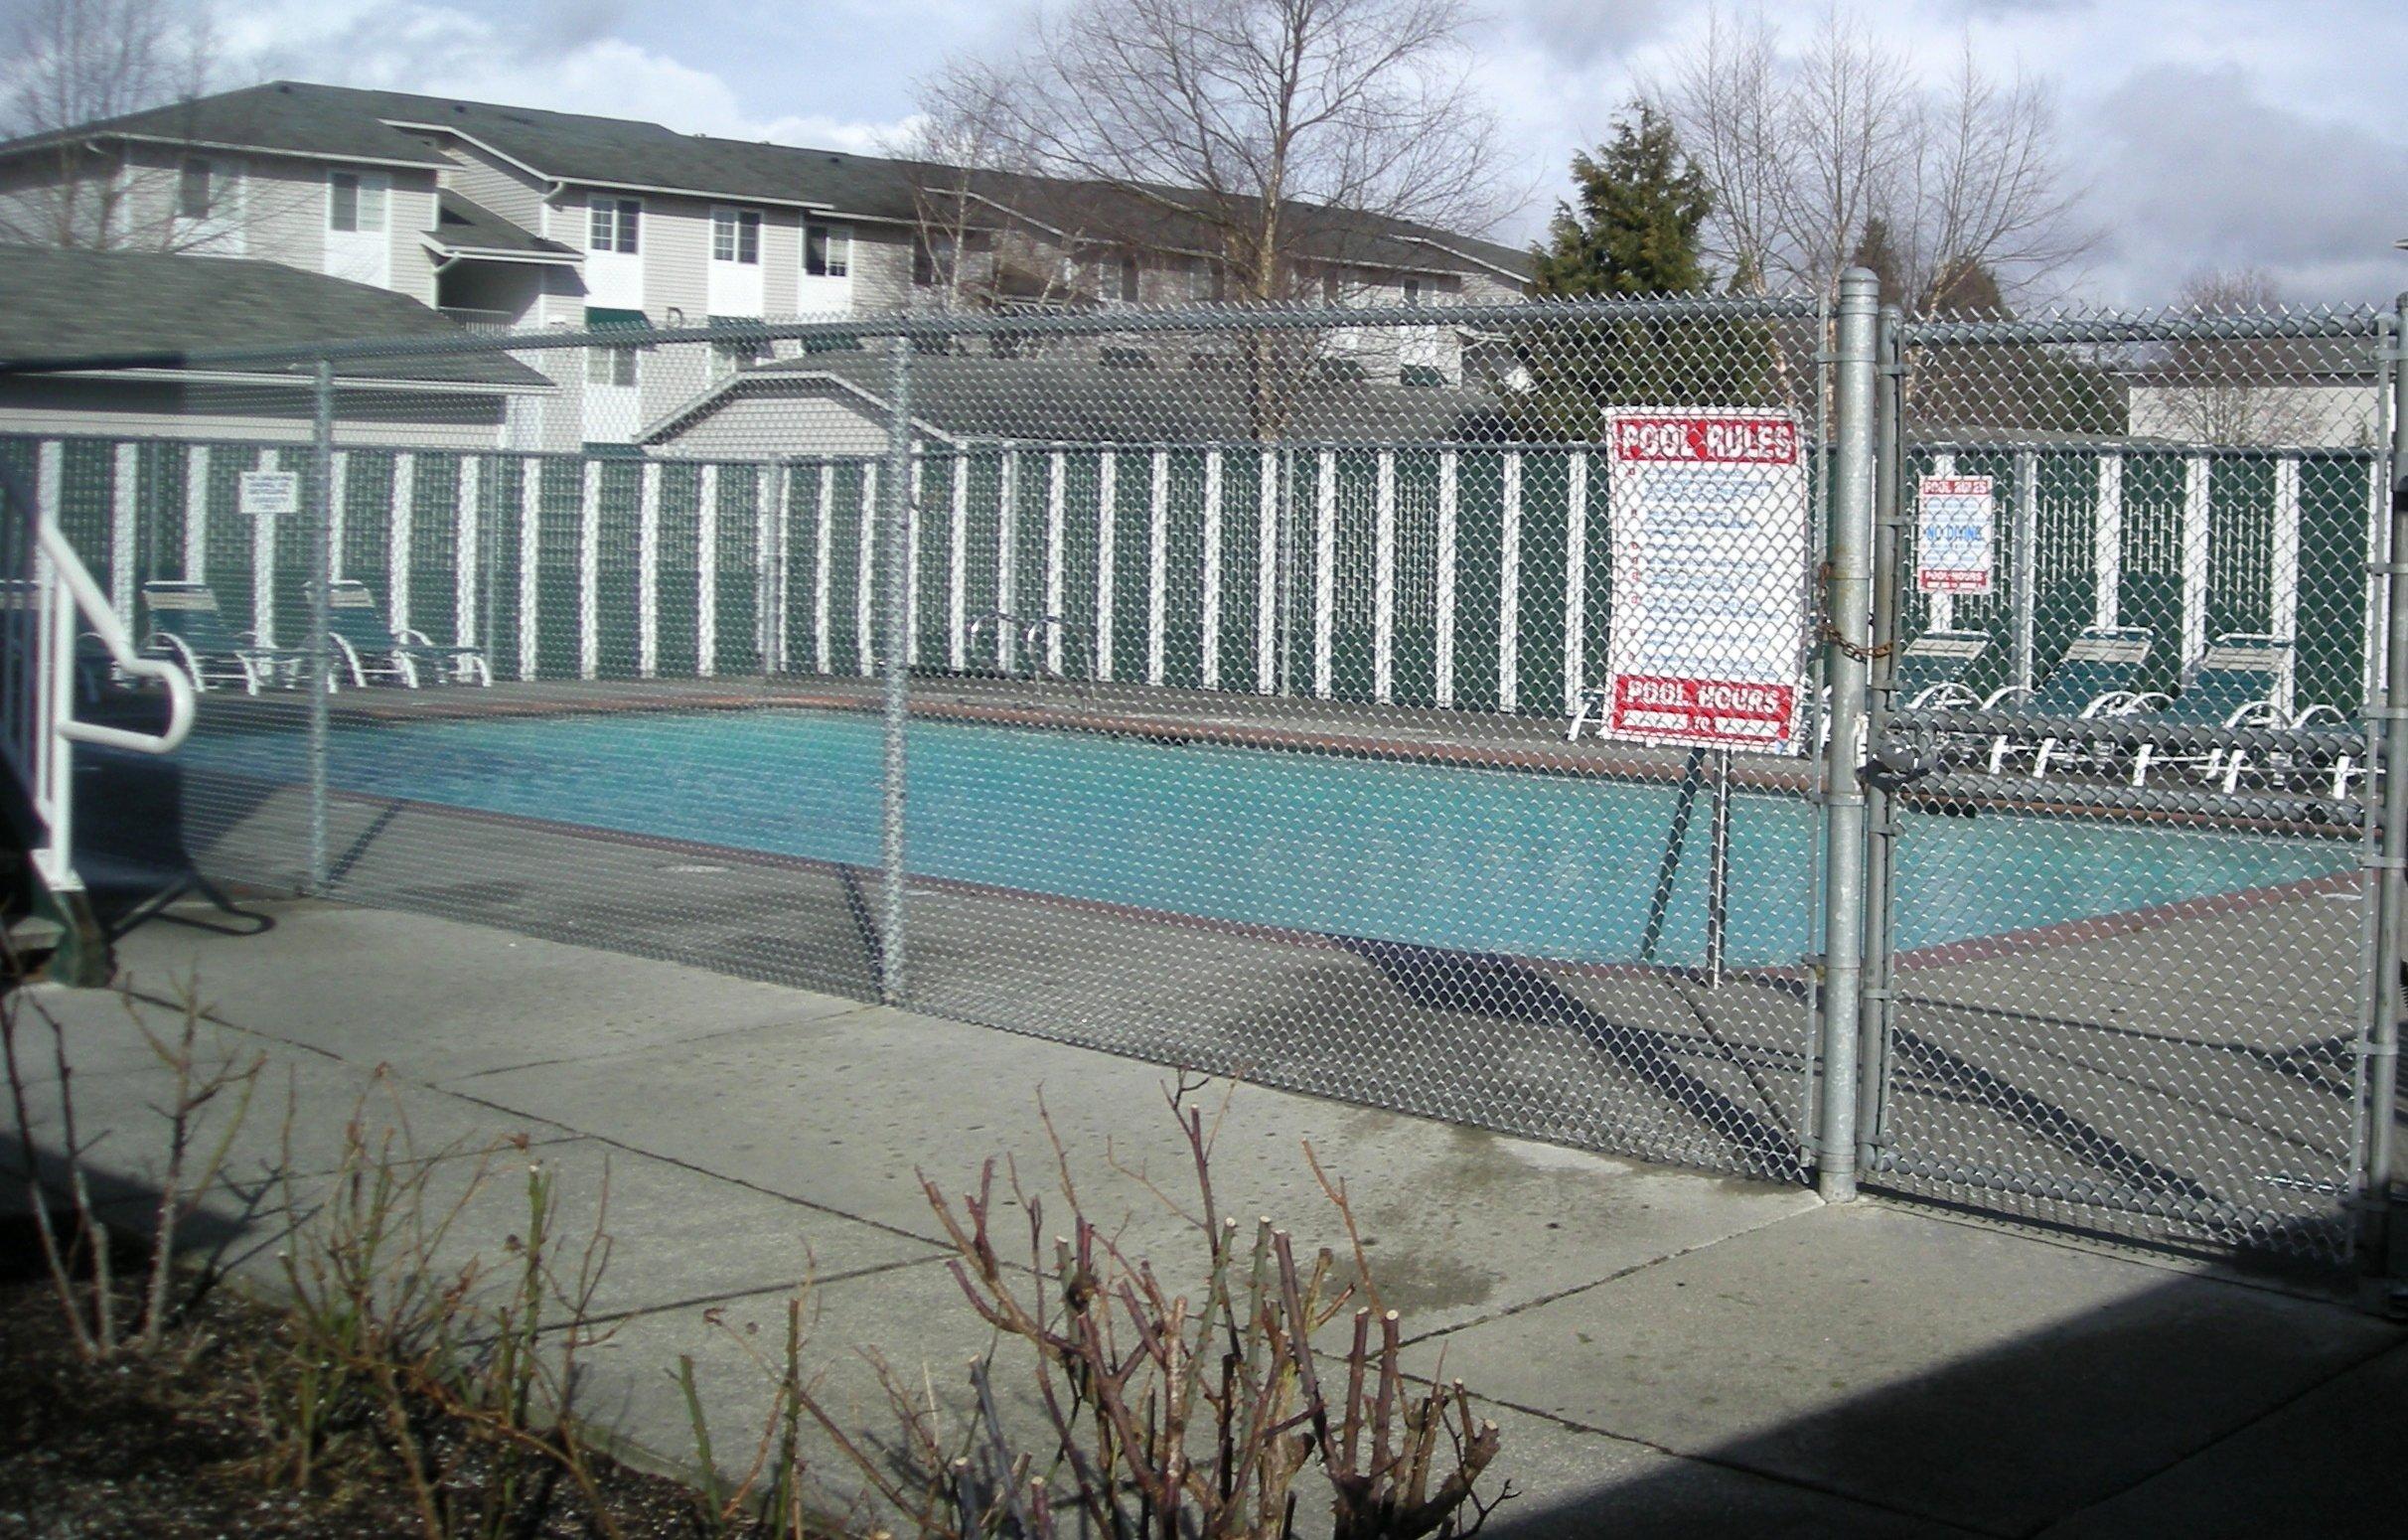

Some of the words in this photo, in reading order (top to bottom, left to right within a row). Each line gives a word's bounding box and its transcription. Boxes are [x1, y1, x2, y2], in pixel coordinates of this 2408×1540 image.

[1622, 424, 1693, 457] POOL
[1708, 425, 1791, 458] RULES
[1924, 481, 1951, 494] POOL
[1925, 571, 1949, 581] POOL
[1627, 681, 1690, 706] POOL
[1698, 686, 1779, 713] HOURS
